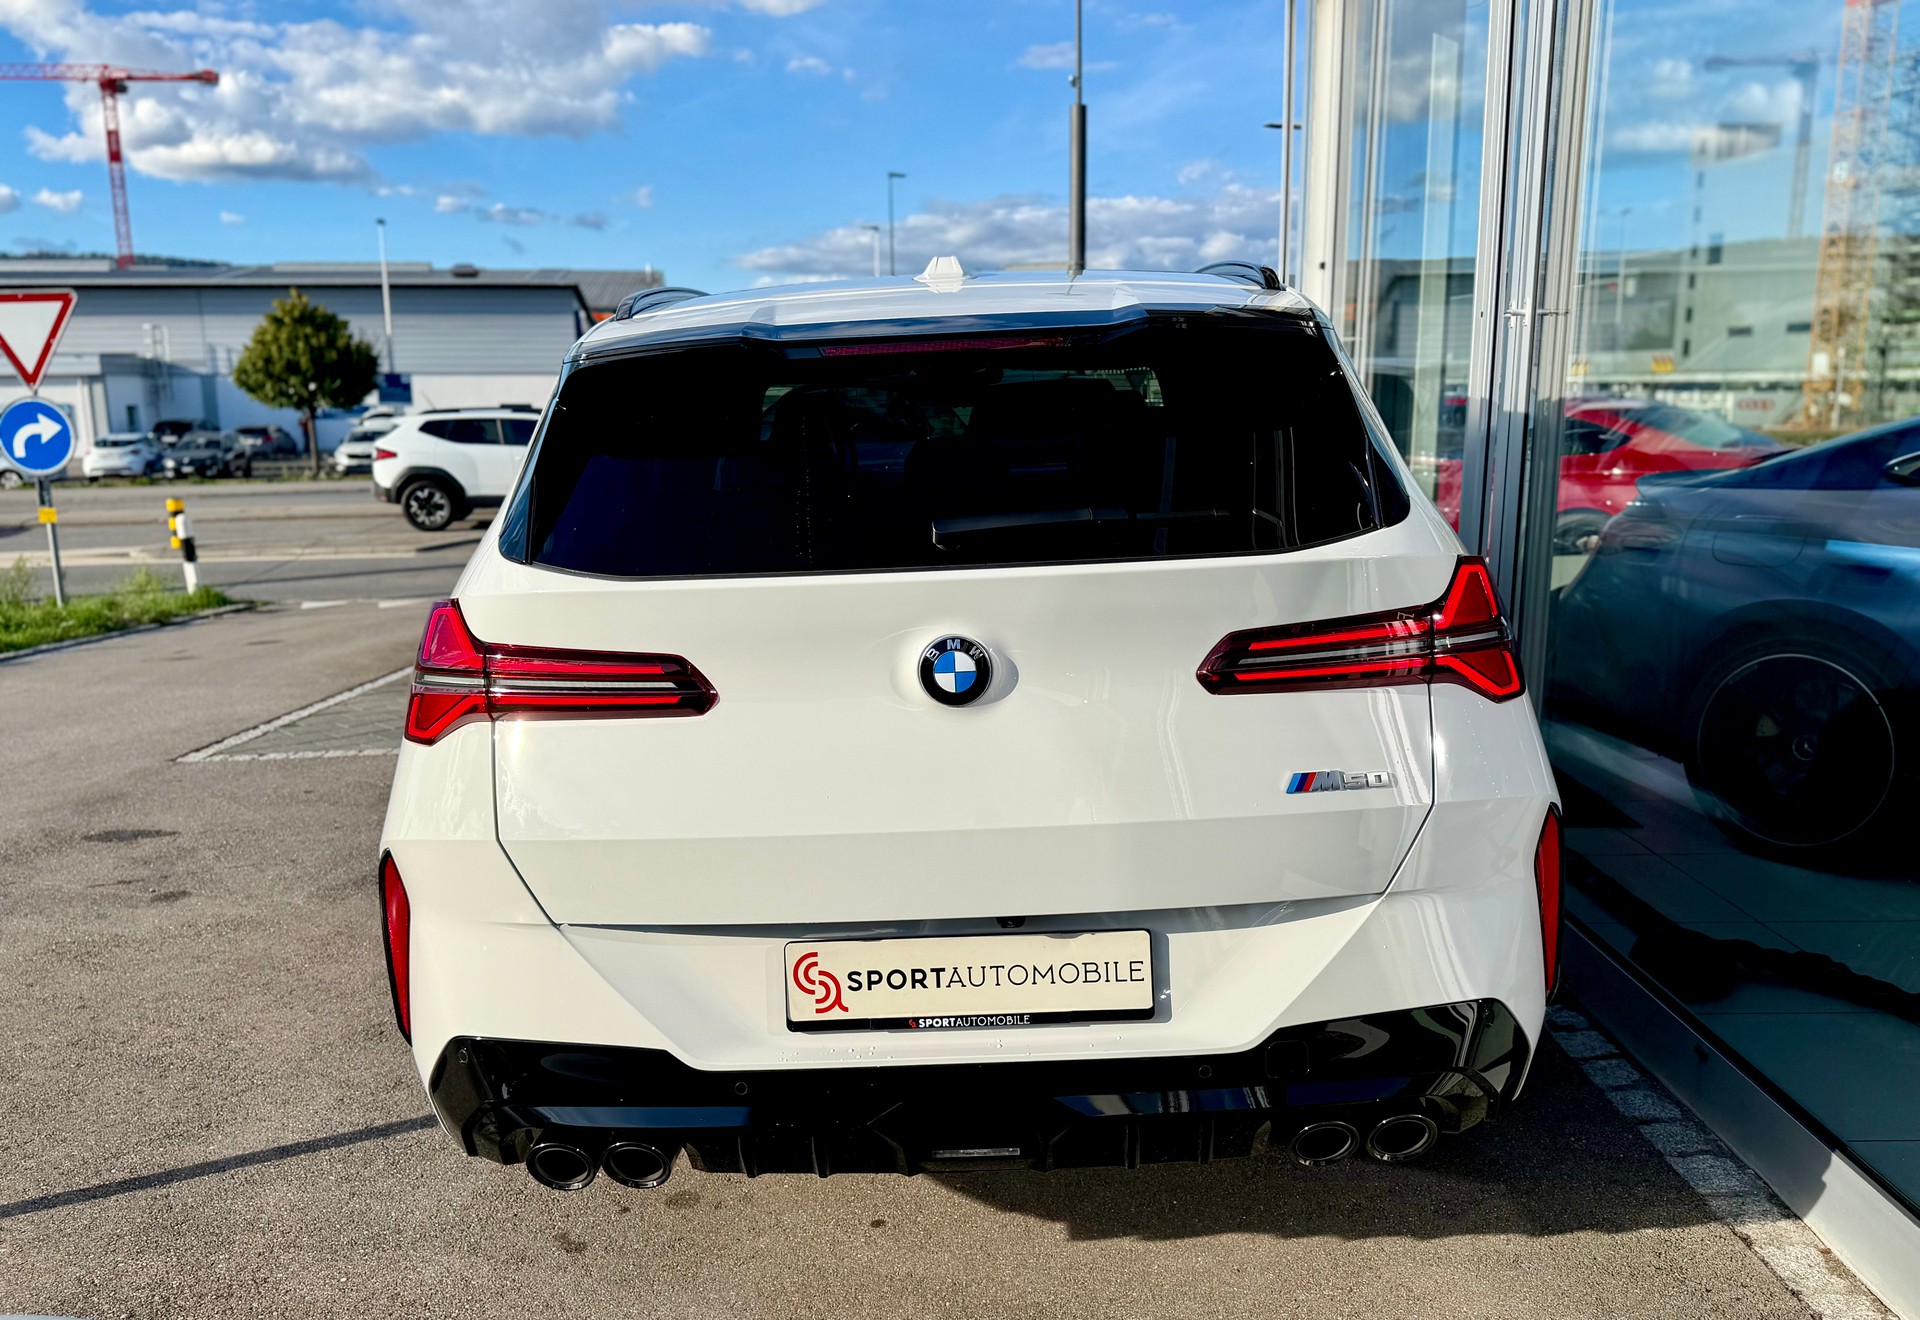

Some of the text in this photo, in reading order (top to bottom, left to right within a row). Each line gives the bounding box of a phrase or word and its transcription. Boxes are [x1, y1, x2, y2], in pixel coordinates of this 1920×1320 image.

[926, 639, 984, 661] BMW
[1308, 769, 1389, 792] M50
[847, 960, 1145, 992] SPORTAUTOMOBILE
[919, 1015, 1031, 1028] SPORTAUTOMOBILE
